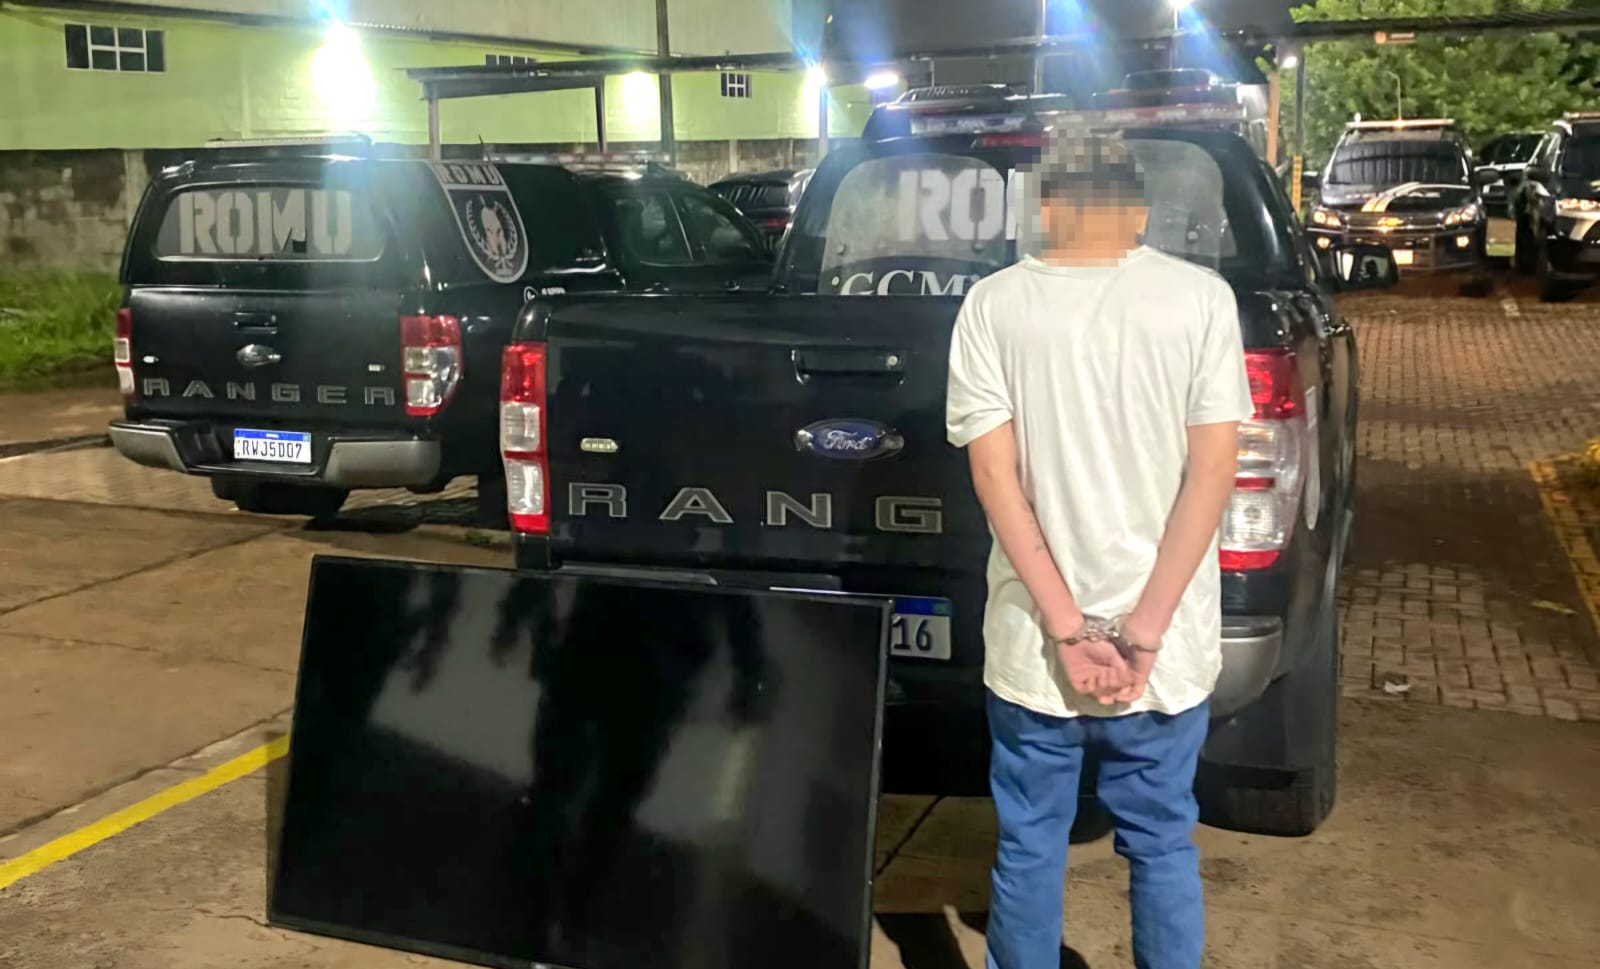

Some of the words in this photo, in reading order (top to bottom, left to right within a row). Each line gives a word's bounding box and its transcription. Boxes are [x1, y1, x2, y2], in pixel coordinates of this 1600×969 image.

[433, 162, 503, 185] ROMU
[900, 168, 1016, 241] RO
[179, 190, 352, 255] ROMU
[143, 378, 396, 407] RANGER
[242, 439, 303, 459] RWJ5D07
[823, 429, 874, 451] Ford
[568, 482, 943, 534] RANG
[892, 617, 932, 652] 16
